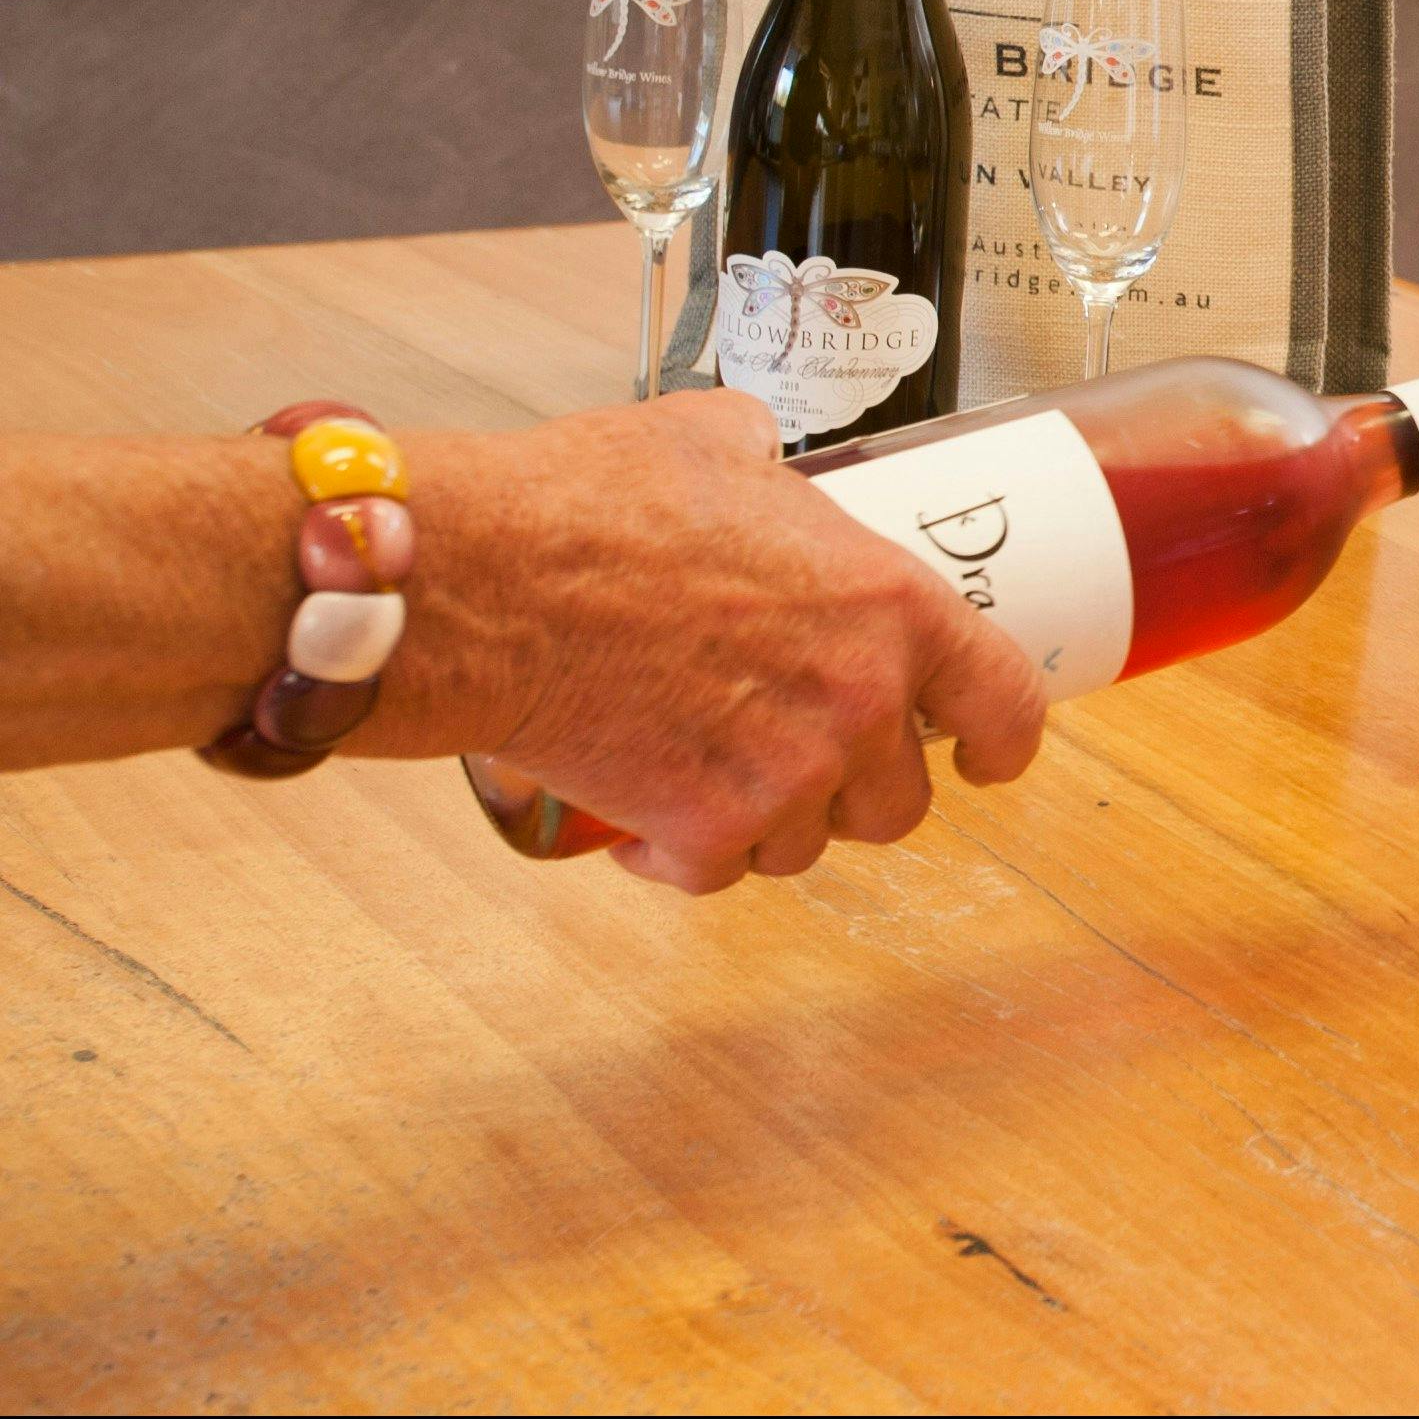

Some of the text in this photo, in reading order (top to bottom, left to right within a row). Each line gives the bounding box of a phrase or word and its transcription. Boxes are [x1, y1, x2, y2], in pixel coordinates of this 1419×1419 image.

[608, 67, 637, 84] Bridge
[639, 70, 672, 85] Wines
[801, 329, 920, 351] BRIDGE
